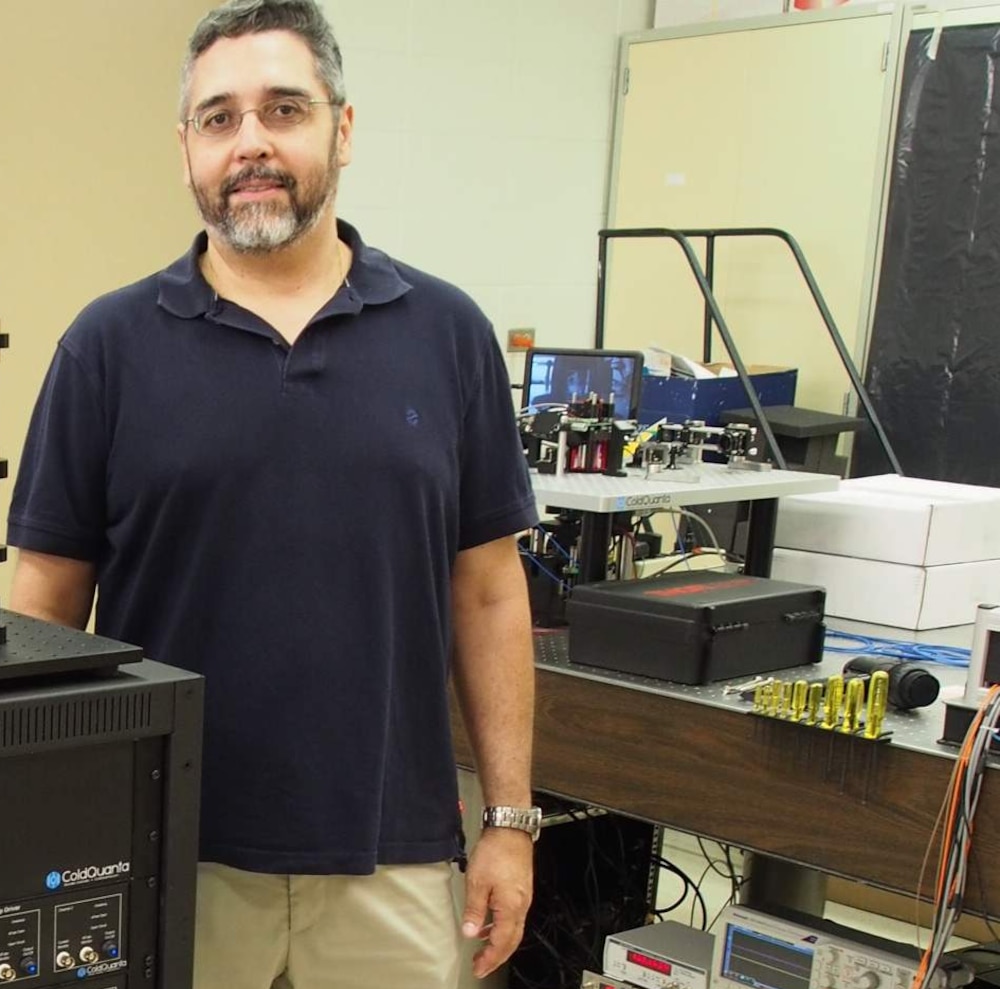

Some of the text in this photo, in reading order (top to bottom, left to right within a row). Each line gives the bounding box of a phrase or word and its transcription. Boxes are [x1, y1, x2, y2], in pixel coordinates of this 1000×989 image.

[625, 493, 671, 507] ColdQuanta
[61, 861, 130, 883] ColdQuanta
[86, 960, 127, 974] ColdQuanta
